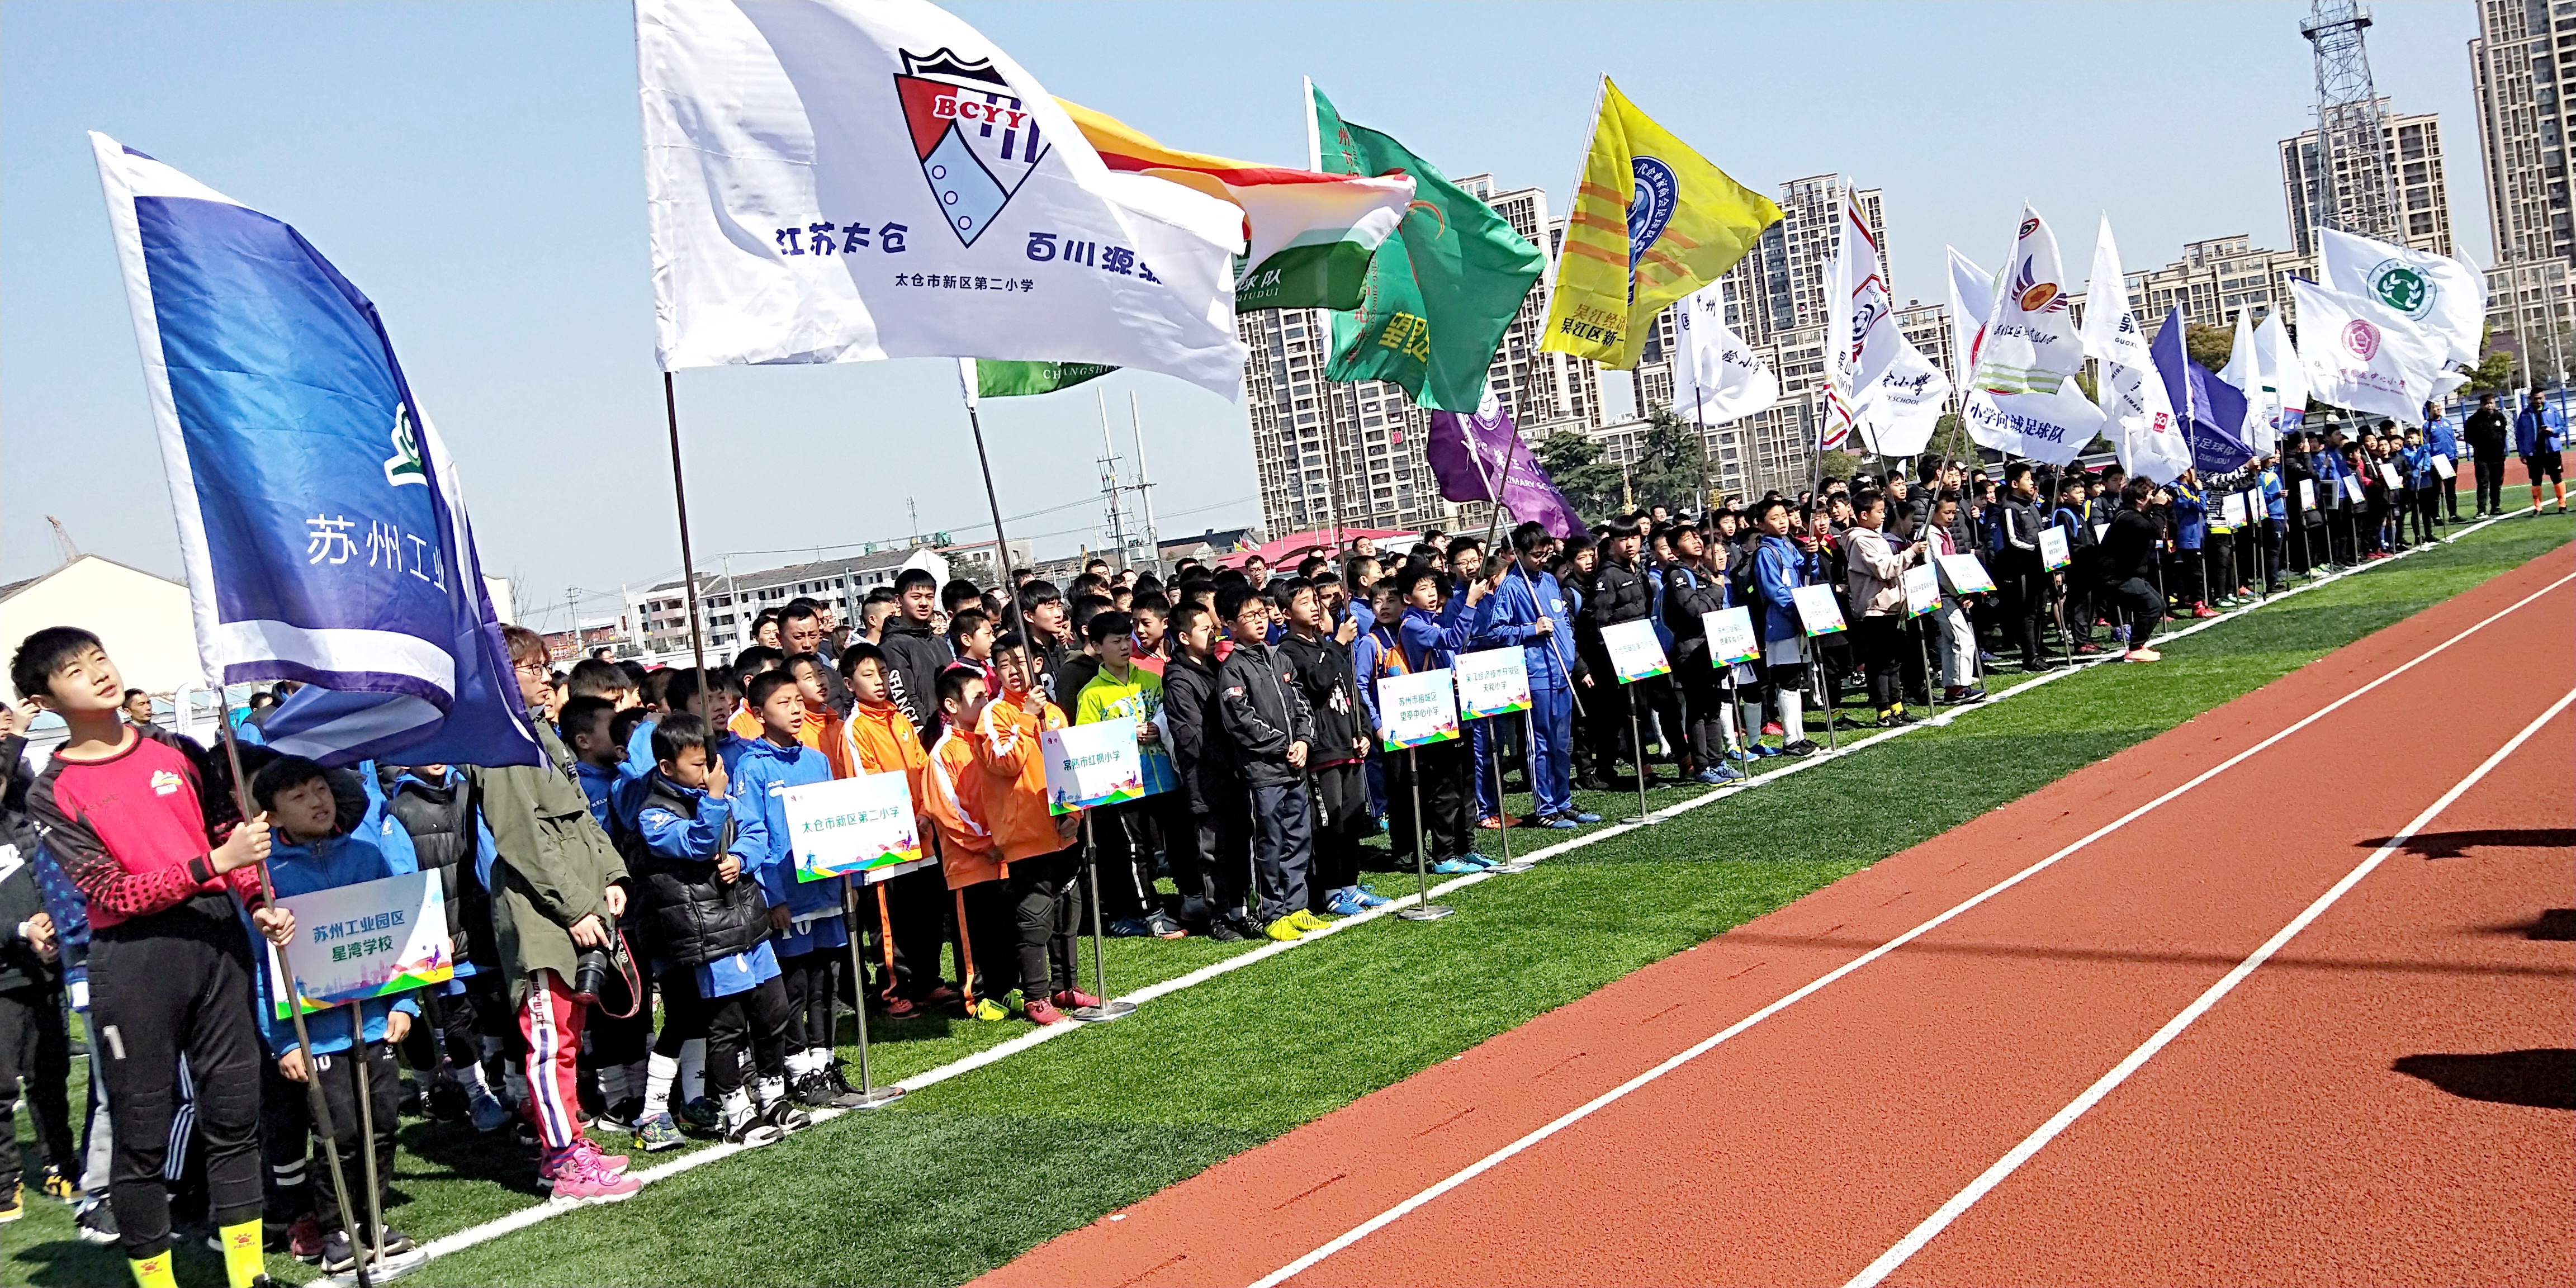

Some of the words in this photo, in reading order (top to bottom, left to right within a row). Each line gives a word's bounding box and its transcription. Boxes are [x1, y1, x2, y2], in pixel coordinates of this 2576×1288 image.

[935, 96, 1027, 129] BCYY
[776, 221, 908, 256] 江苏太仓
[895, 273, 1034, 292] 太仓市新区第二小学
[1892, 397, 1920, 406] SCHOOL
[1970, 402, 2066, 444] 小学向诚足球队
[306, 513, 447, 594] 苏州工业
[1399, 691, 1437, 707] 苏州市相城区
[1400, 705, 1439, 722] 望亭中心小学
[1063, 749, 1120, 771] 常熟市红枫小学
[802, 805, 899, 834] 太仓市新区第二小学
[312, 910, 405, 944] 苏州工业园区
[332, 935, 394, 962] 星湾学校
